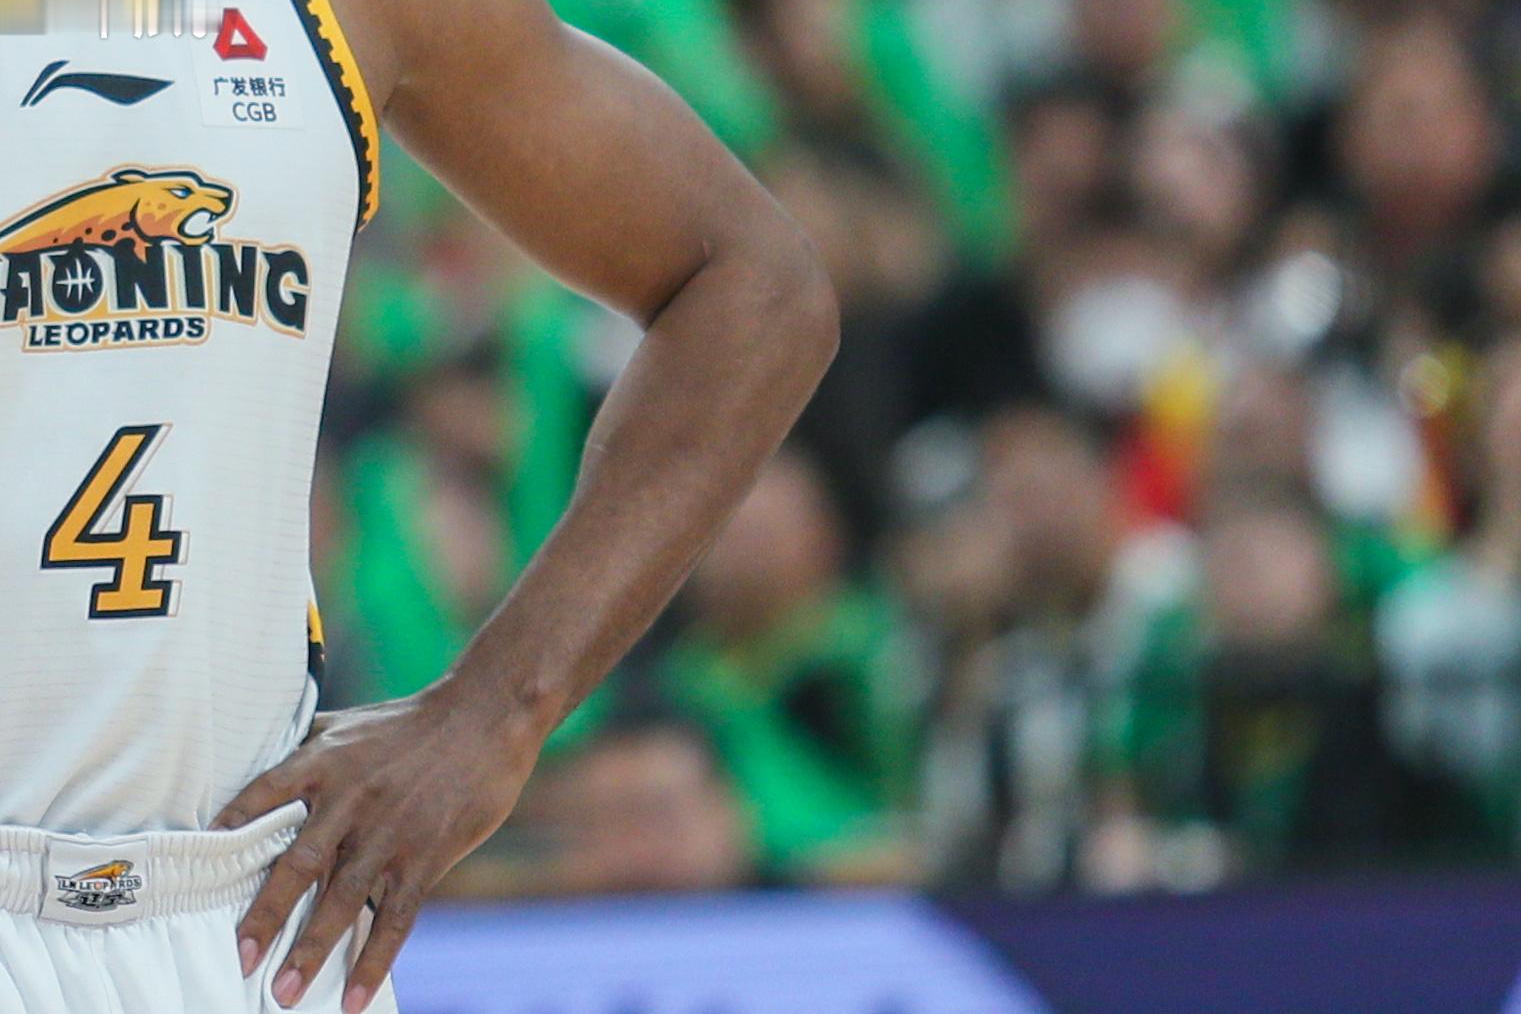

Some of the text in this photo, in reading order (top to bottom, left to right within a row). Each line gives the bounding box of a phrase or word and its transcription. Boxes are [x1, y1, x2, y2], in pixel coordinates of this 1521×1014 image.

[213, 77, 286, 97] 广发银行
[232, 102, 277, 122] CGB
[28, 316, 206, 347] LEOPARDS
[41, 423, 185, 620] 4
